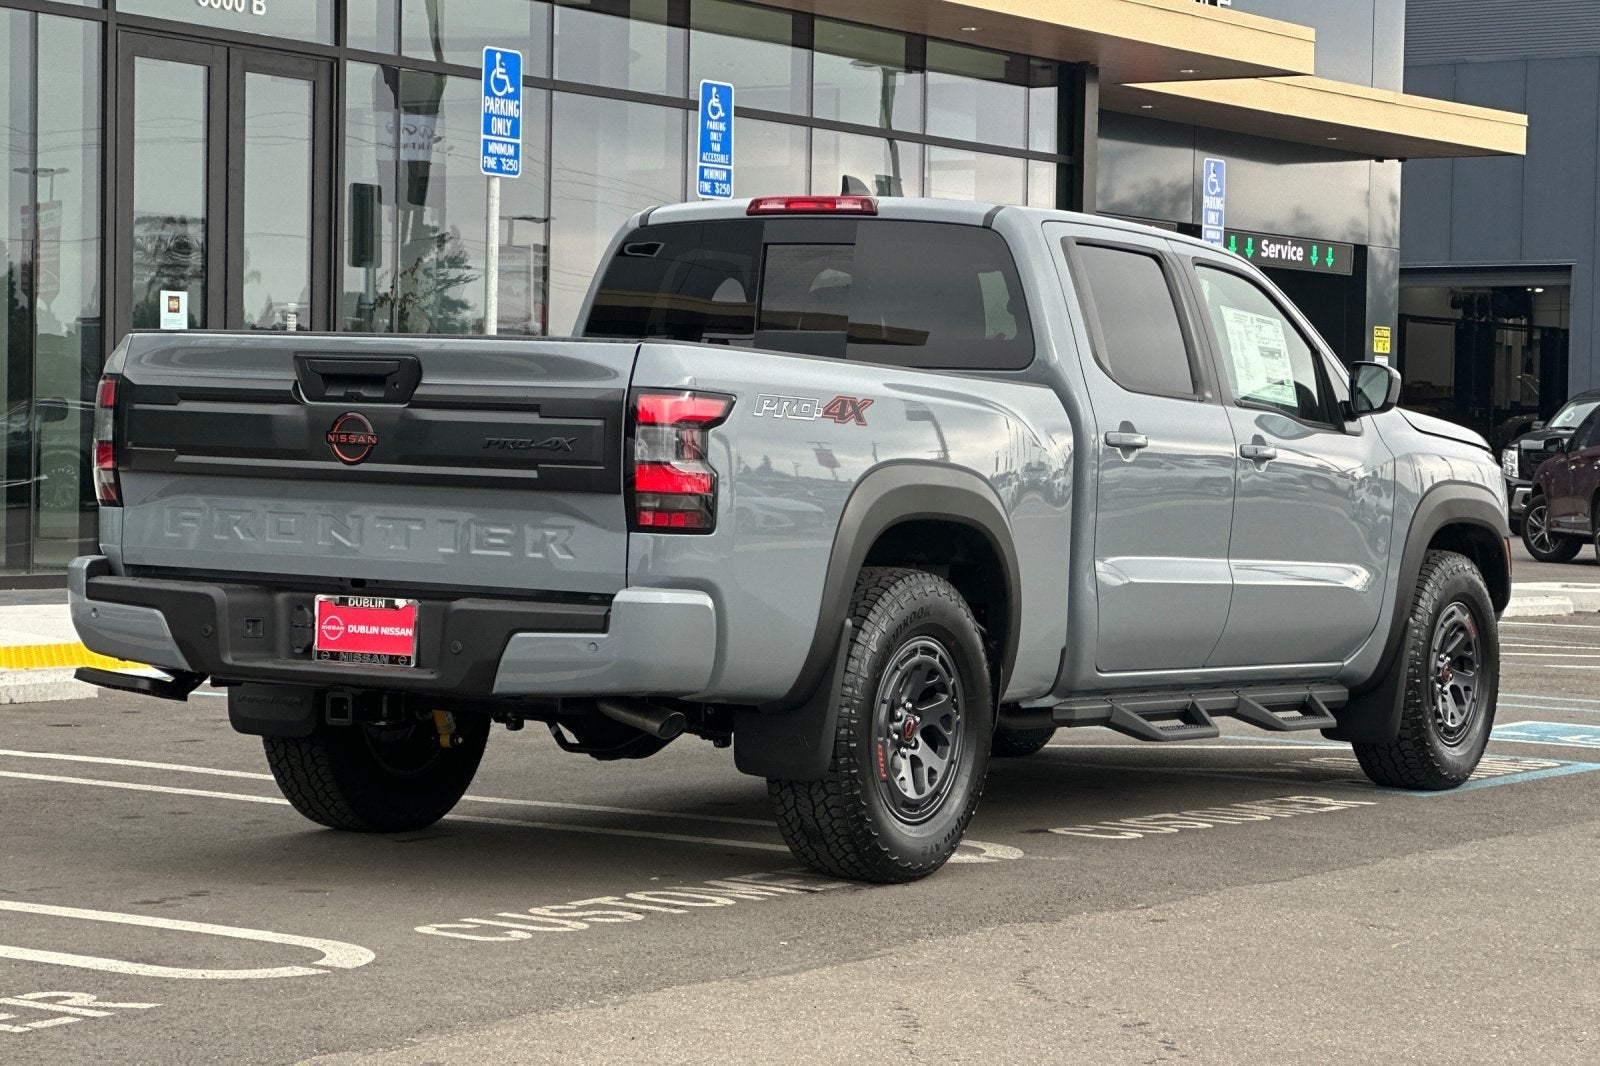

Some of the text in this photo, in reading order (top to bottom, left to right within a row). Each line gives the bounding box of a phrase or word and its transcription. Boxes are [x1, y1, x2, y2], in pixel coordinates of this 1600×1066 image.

[485, 96, 519, 118] PARKING
[491, 116, 512, 136] ONLY
[706, 121, 726, 131] PARKING
[710, 132, 722, 142] ONLY
[488, 142, 515, 156] MINIMUM
[711, 142, 721, 152] VAN
[484, 156, 518, 172] FINE $250
[702, 152, 729, 163] ACCESSIBLE
[703, 168, 727, 181] MINIMUM
[700, 181, 730, 195] FINE $250
[1204, 196, 1223, 210] PARKING
[1207, 211, 1220, 225] ONLY
[1261, 239, 1304, 261] Service
[753, 393, 874, 426] PRO-4X
[327, 432, 378, 445] NISSAN
[484, 436, 578, 452] PRO-4X
[163, 505, 577, 560] FRONTIER
[348, 597, 386, 608] DUBLIN
[347, 624, 413, 636] DUBLIN NISSAN
[339, 652, 389, 664] NISSAN
[1048, 796, 1378, 839] CUSTOMER
[414, 869, 853, 941] CUSTOME
